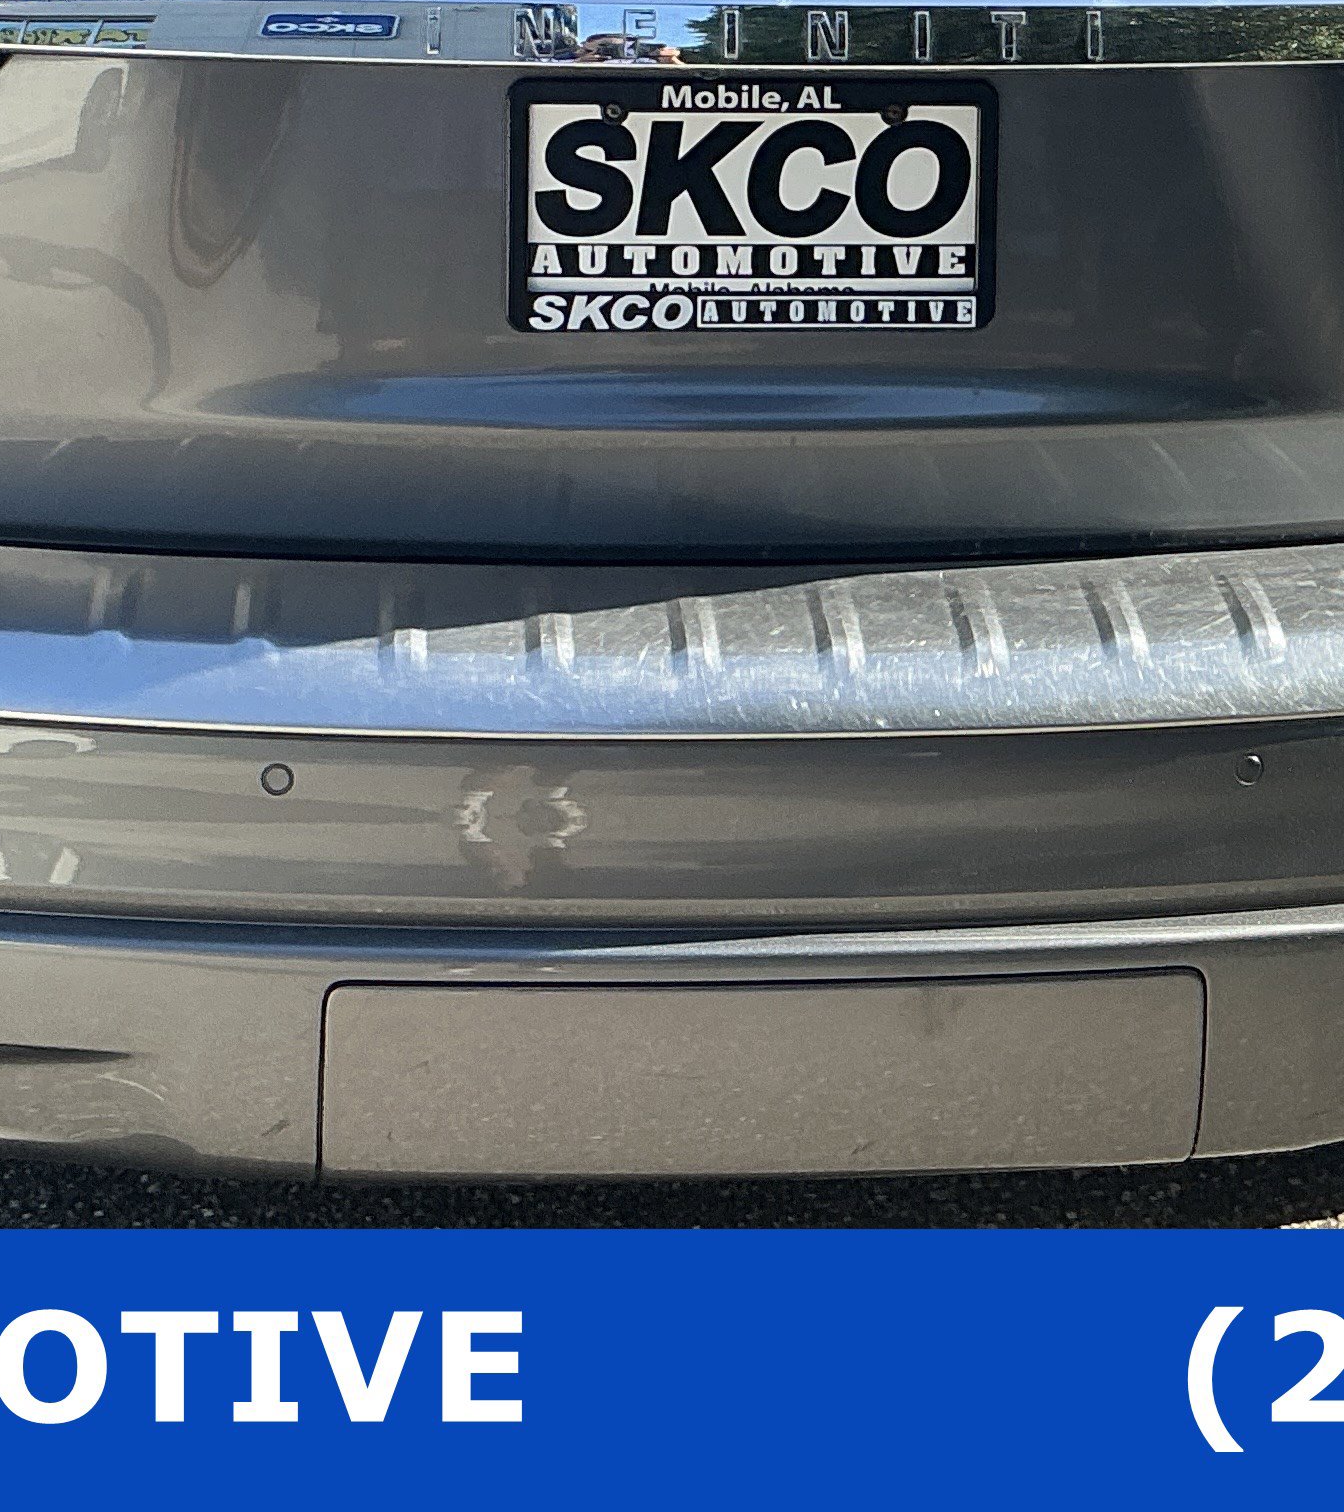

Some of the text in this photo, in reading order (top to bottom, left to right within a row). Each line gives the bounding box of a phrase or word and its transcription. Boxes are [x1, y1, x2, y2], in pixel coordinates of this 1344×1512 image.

[427, 6, 1104, 61] INFINITI
[661, 85, 842, 112] Mobile, AL
[534, 118, 972, 238] SKCO
[531, 245, 967, 276] AUTOMOTIVE
[528, 294, 972, 330] SKCO AUTOMOTIVE
